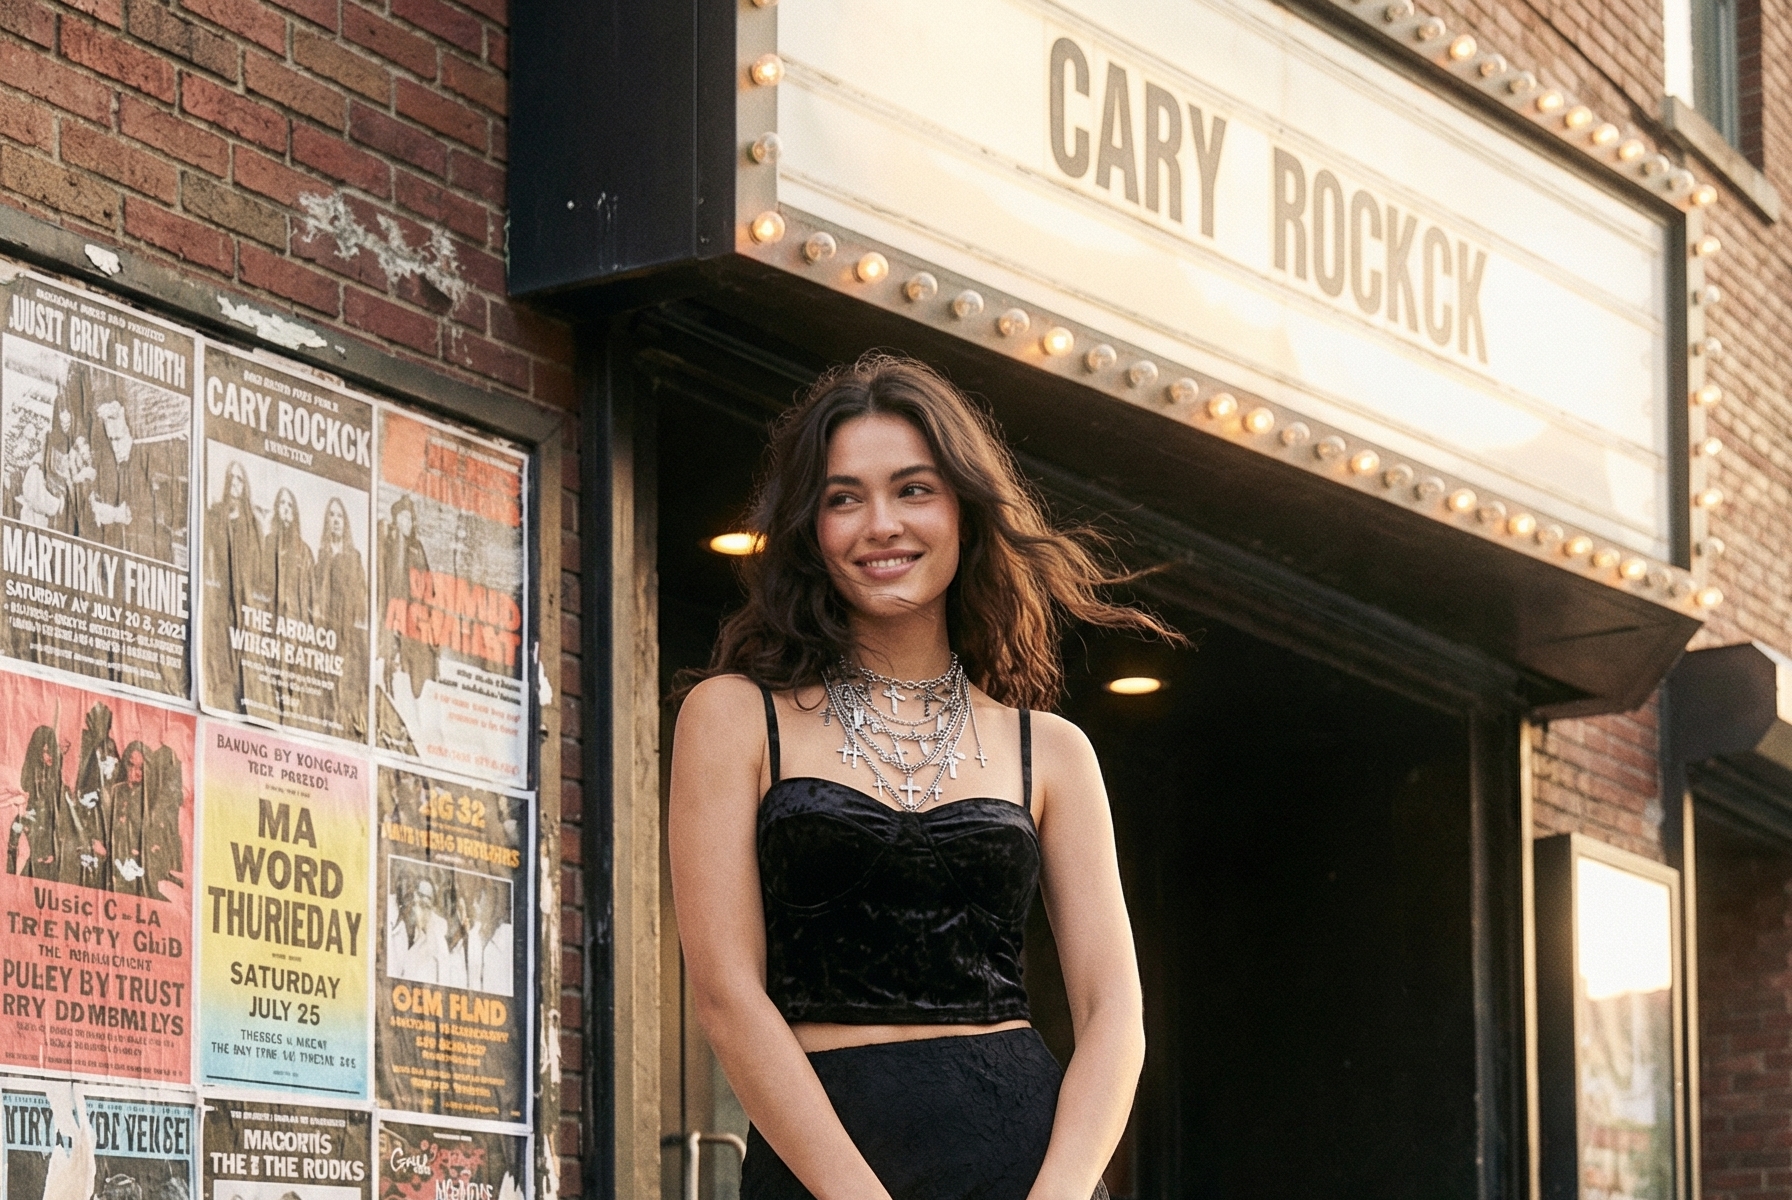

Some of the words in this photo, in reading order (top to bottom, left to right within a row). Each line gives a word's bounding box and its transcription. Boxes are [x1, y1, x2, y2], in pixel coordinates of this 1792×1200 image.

[1050, 37, 1226, 239] CARY
[1273, 147, 1488, 364] ROCKCK
[207, 375, 272, 433] CARY
[278, 400, 371, 468] ROCKCK
[242, 604, 273, 633] THE
[274, 748, 292, 763] BY
[259, 798, 317, 849] MA
[230, 841, 344, 900] WORD
[208, 885, 362, 957] THURIEDAY
[79, 969, 109, 999] BY
[115, 974, 185, 1008] TRUST
[230, 961, 340, 1000] SATURDAY
[249, 995, 292, 1022] JULY
[298, 1003, 321, 1026] 25
[210, 1152, 247, 1175] THE
[263, 1154, 298, 1178] THE
